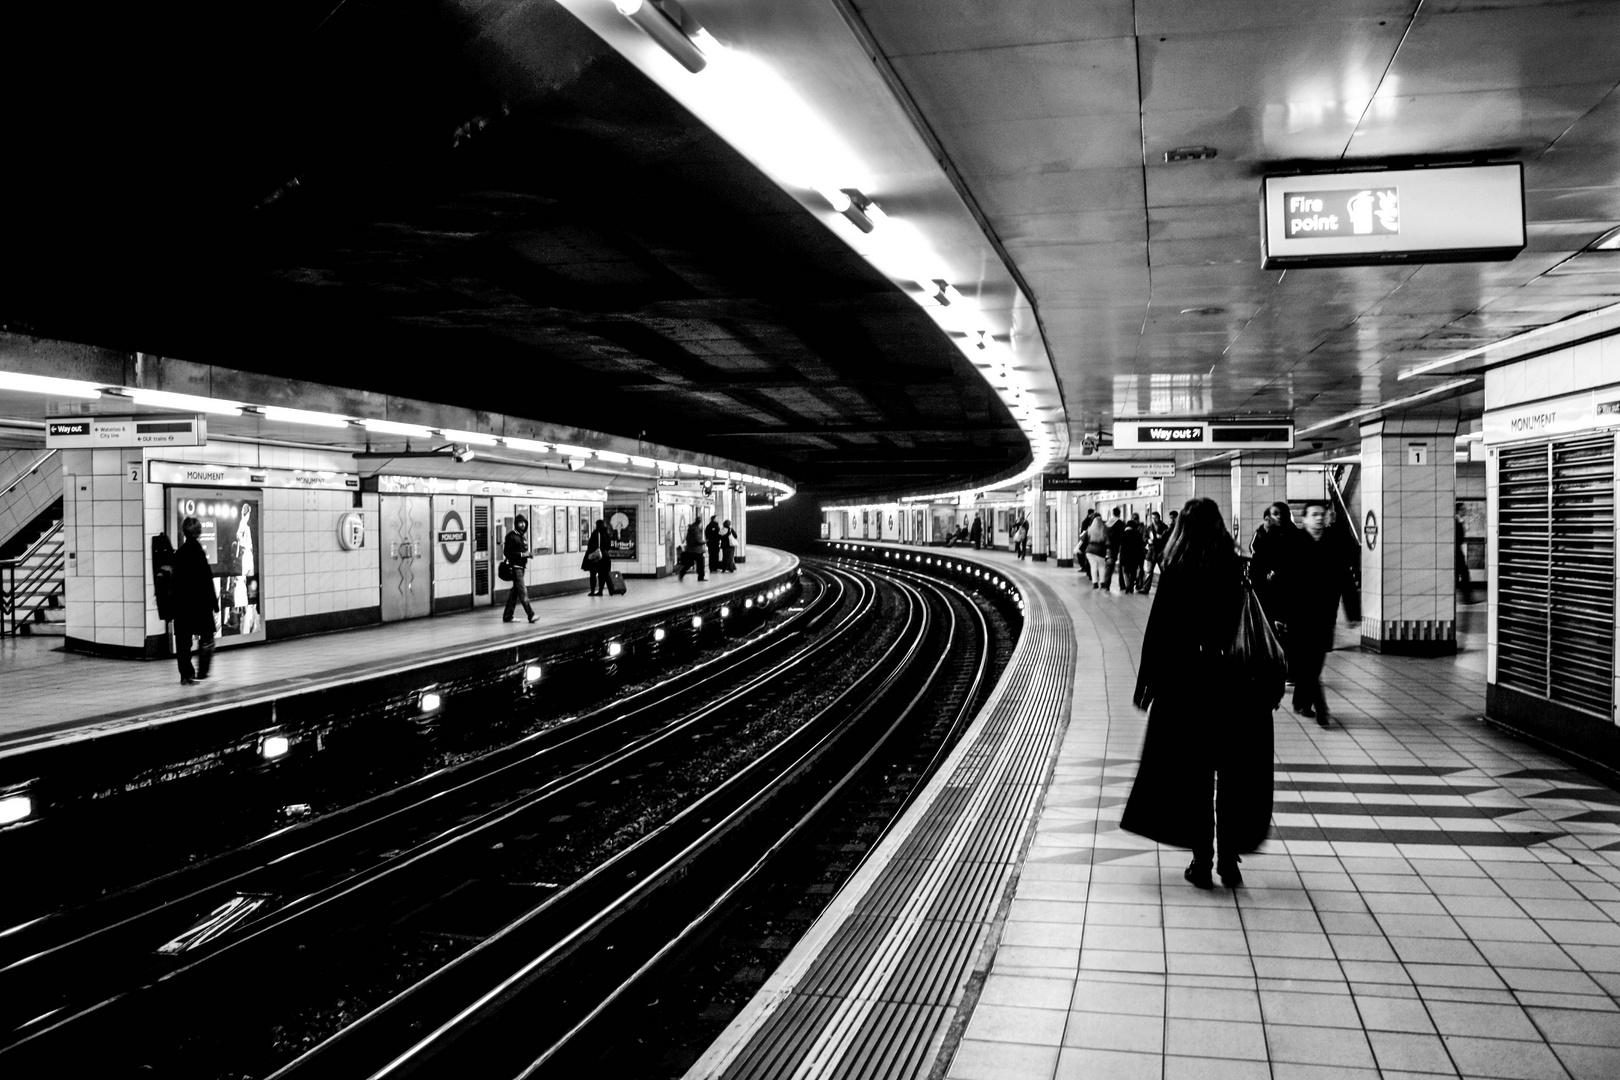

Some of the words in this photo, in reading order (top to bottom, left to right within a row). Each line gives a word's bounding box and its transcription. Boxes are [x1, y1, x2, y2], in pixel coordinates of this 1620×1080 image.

[1290, 196, 1323, 213] Fire
[1291, 214, 1339, 235] point
[1511, 411, 1556, 432] MONUMENT
[58, 425, 71, 434] Way
[71, 425, 83, 433] out
[1150, 428, 1171, 440] Way
[1172, 428, 1192, 439] out
[1415, 452, 1420, 463] 1
[132, 471, 138, 481] 2
[187, 471, 225, 481] MONUMENT
[441, 533, 464, 541] MONUMENT
